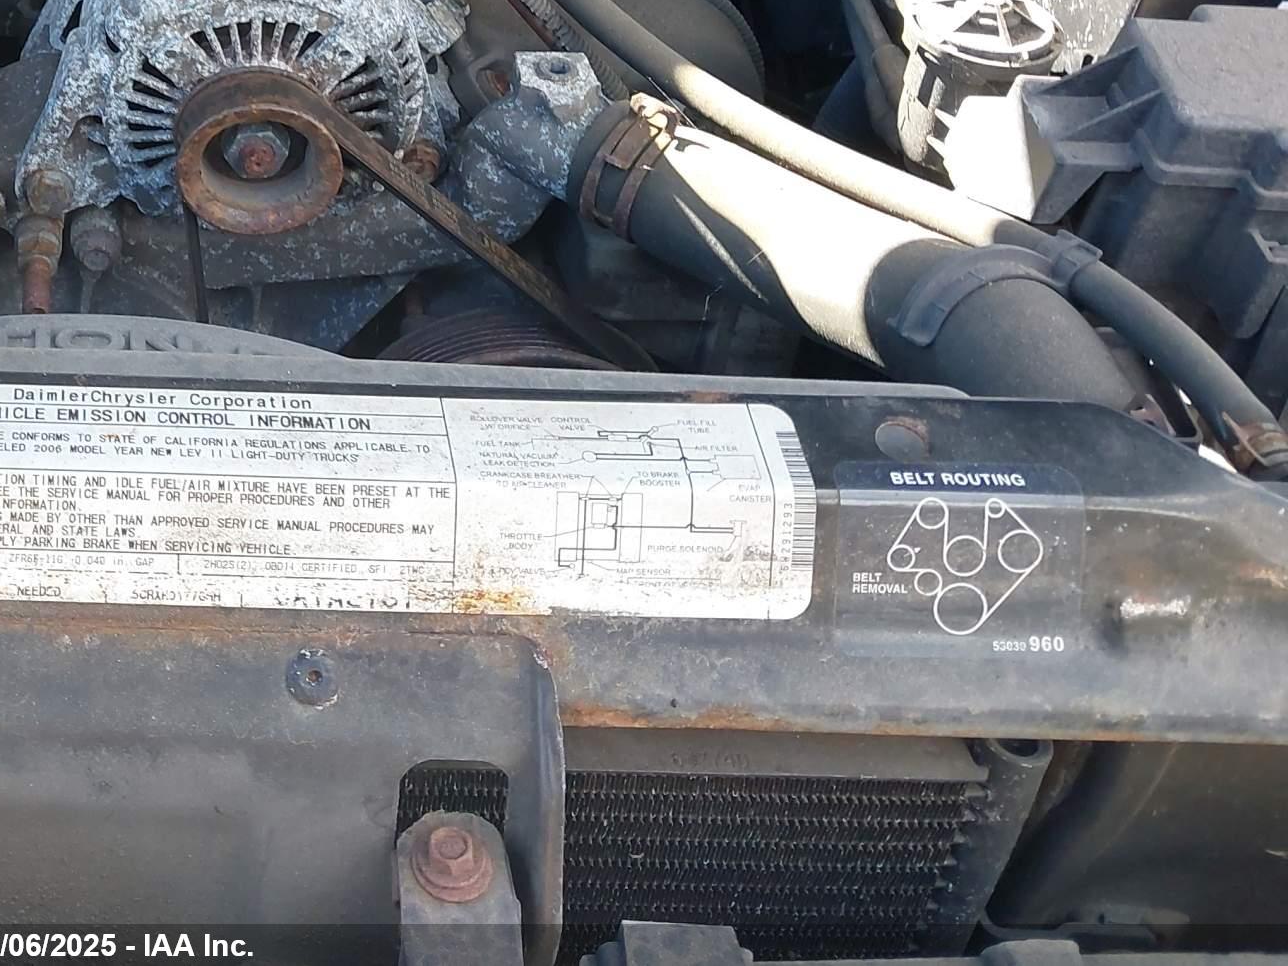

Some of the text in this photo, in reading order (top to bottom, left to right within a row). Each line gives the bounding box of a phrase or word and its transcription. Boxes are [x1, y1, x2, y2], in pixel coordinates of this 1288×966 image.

[13, 388, 312, 411] DaimlerChrysler Corporation
[57, 408, 146, 424] EMISSION
[157, 412, 235, 427] CONTROL
[249, 415, 371, 431] INFORMATION
[12, 432, 70, 442] CONFORMS
[78, 433, 92, 443] TO
[98, 434, 135, 444] STATE
[142, 436, 158, 445] OF
[164, 436, 238, 447] CALIFORNIA
[245, 438, 327, 450] REGULATIONS
[415, 444, 430, 454] TO
[34, 444, 63, 453] 2006
[69, 444, 106, 455] MODEL
[114, 446, 144, 456] YEAR
[150, 447, 173, 457] NEW
[179, 448, 202, 458] LEV
[211, 449, 222, 458] II
[231, 450, 305, 461] LIGHT-DUTY
[313, 452, 359, 463] TRUCKS
[32, 474, 77, 487] TIMING
[84, 476, 107, 488] AND
[116, 477, 143, 489] IDLE
[151, 478, 211, 491] FUEL/AIR
[218, 480, 271, 493] MIXTURE
[277, 482, 309, 494] HAVE
[315, 484, 346, 496] BEEN
[353, 485, 397, 497] PRESET
[405, 487, 420, 498] AT
[428, 487, 451, 499] THE
[890, 471, 1026, 487] BELT ROUTING
[18, 486, 40, 497] THE
[47, 487, 100, 499] SERVICE
[107, 489, 151, 501] MANUAL
[158, 491, 181, 502] FOR
[187, 492, 233, 504] PROPER
[240, 493, 315, 507] PROCEDURES
[323, 495, 345, 507] AND
[353, 496, 391, 509] OTHER
[729, 495, 772, 503] CANISTER
[10, 512, 39, 523] MADE
[47, 513, 62, 523] BY
[69, 513, 106, 525] OTHER
[114, 514, 143, 526] THAN
[151, 515, 210, 528] APPROVED
[217, 517, 270, 530] SERVICE
[277, 520, 321, 532] MANUAL
[329, 521, 405, 534] PROCEDURES
[413, 524, 435, 535] MAY
[32, 524, 54, 535] AND
[61, 525, 98, 537] STATE
[24, 536, 76, 548] PARKING
[83, 538, 120, 550] BRAKE
[128, 539, 158, 551] WHEN
[165, 540, 232, 553] SERVICING
[239, 543, 297, 555] VEHICLE.
[135, 557, 154, 567] GAP
[853, 572, 882, 583] BELT
[852, 583, 908, 594] REMOVAL
